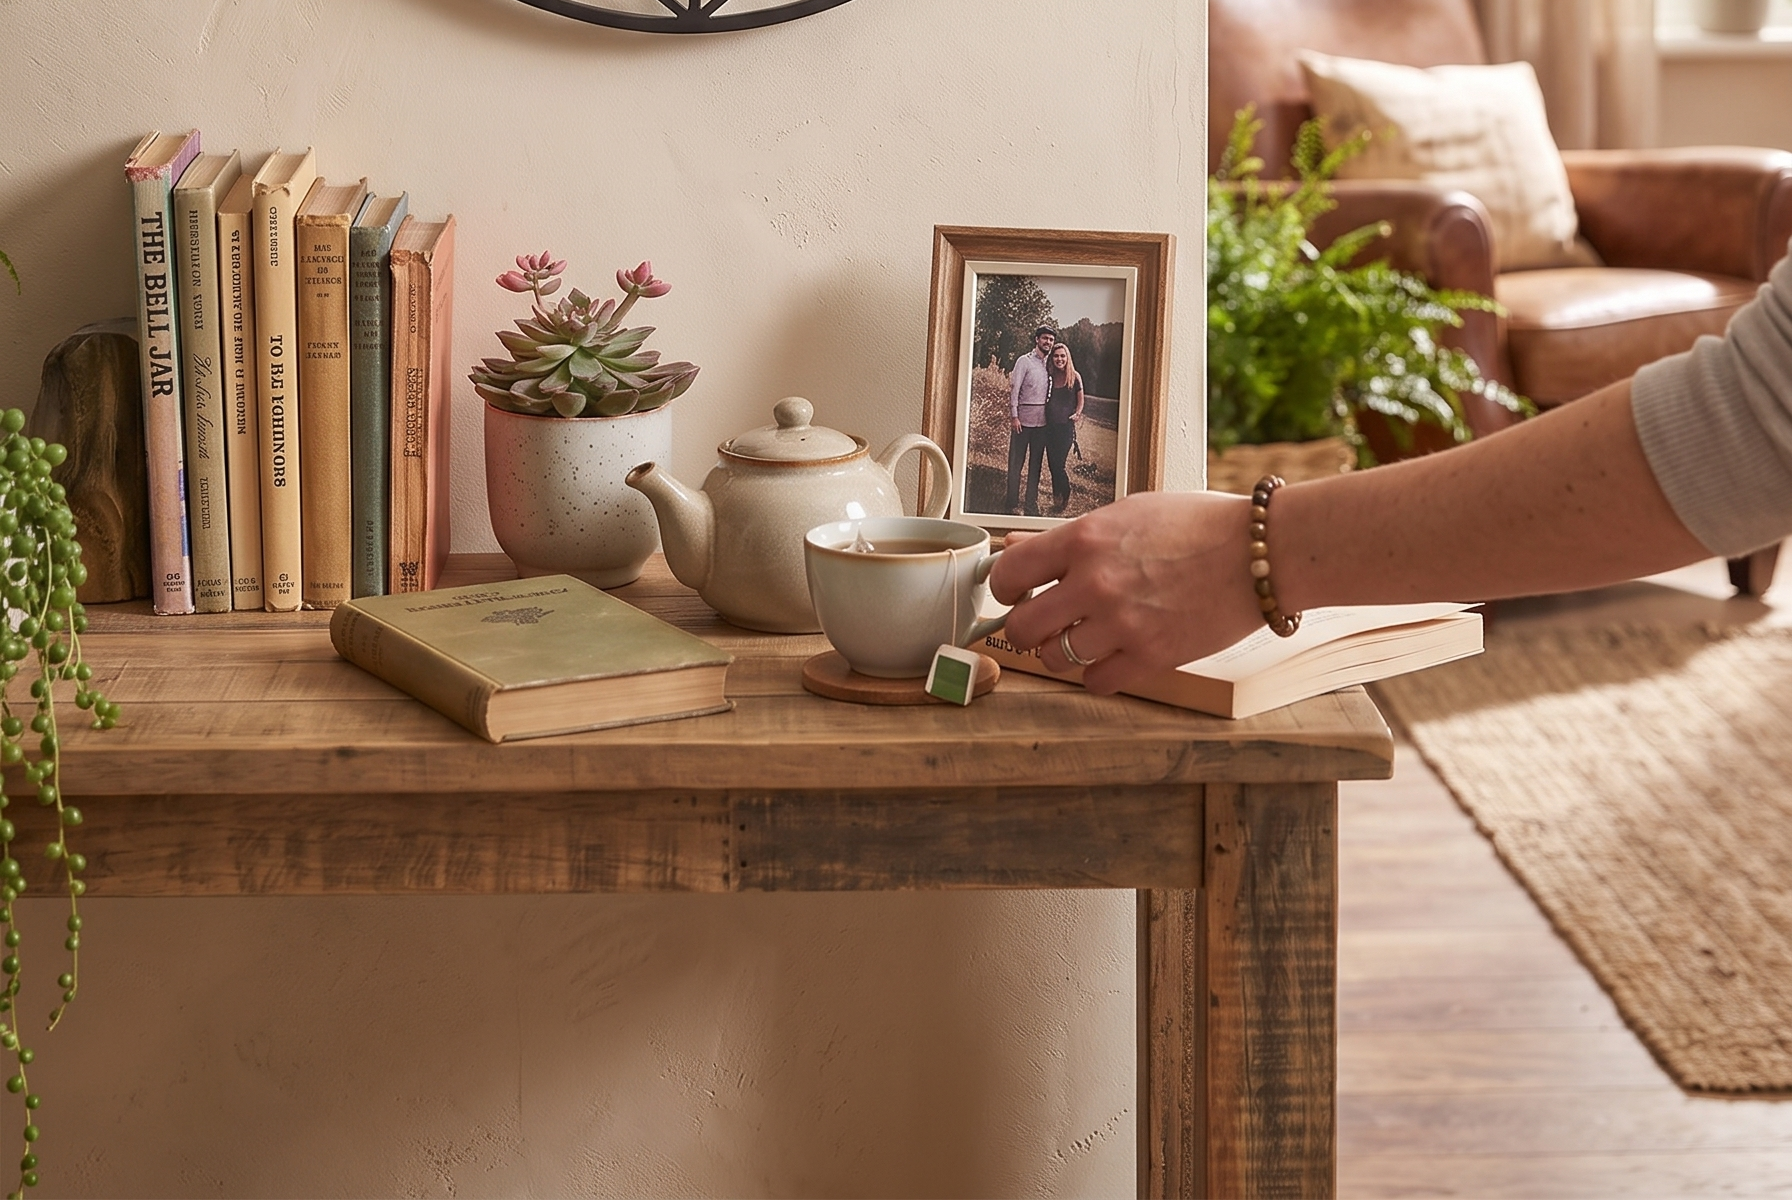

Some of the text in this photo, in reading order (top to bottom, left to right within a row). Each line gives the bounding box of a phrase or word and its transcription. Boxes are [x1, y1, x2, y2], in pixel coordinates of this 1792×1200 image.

[140, 210, 175, 399] THE BELL JAR
[270, 334, 284, 358] TO
